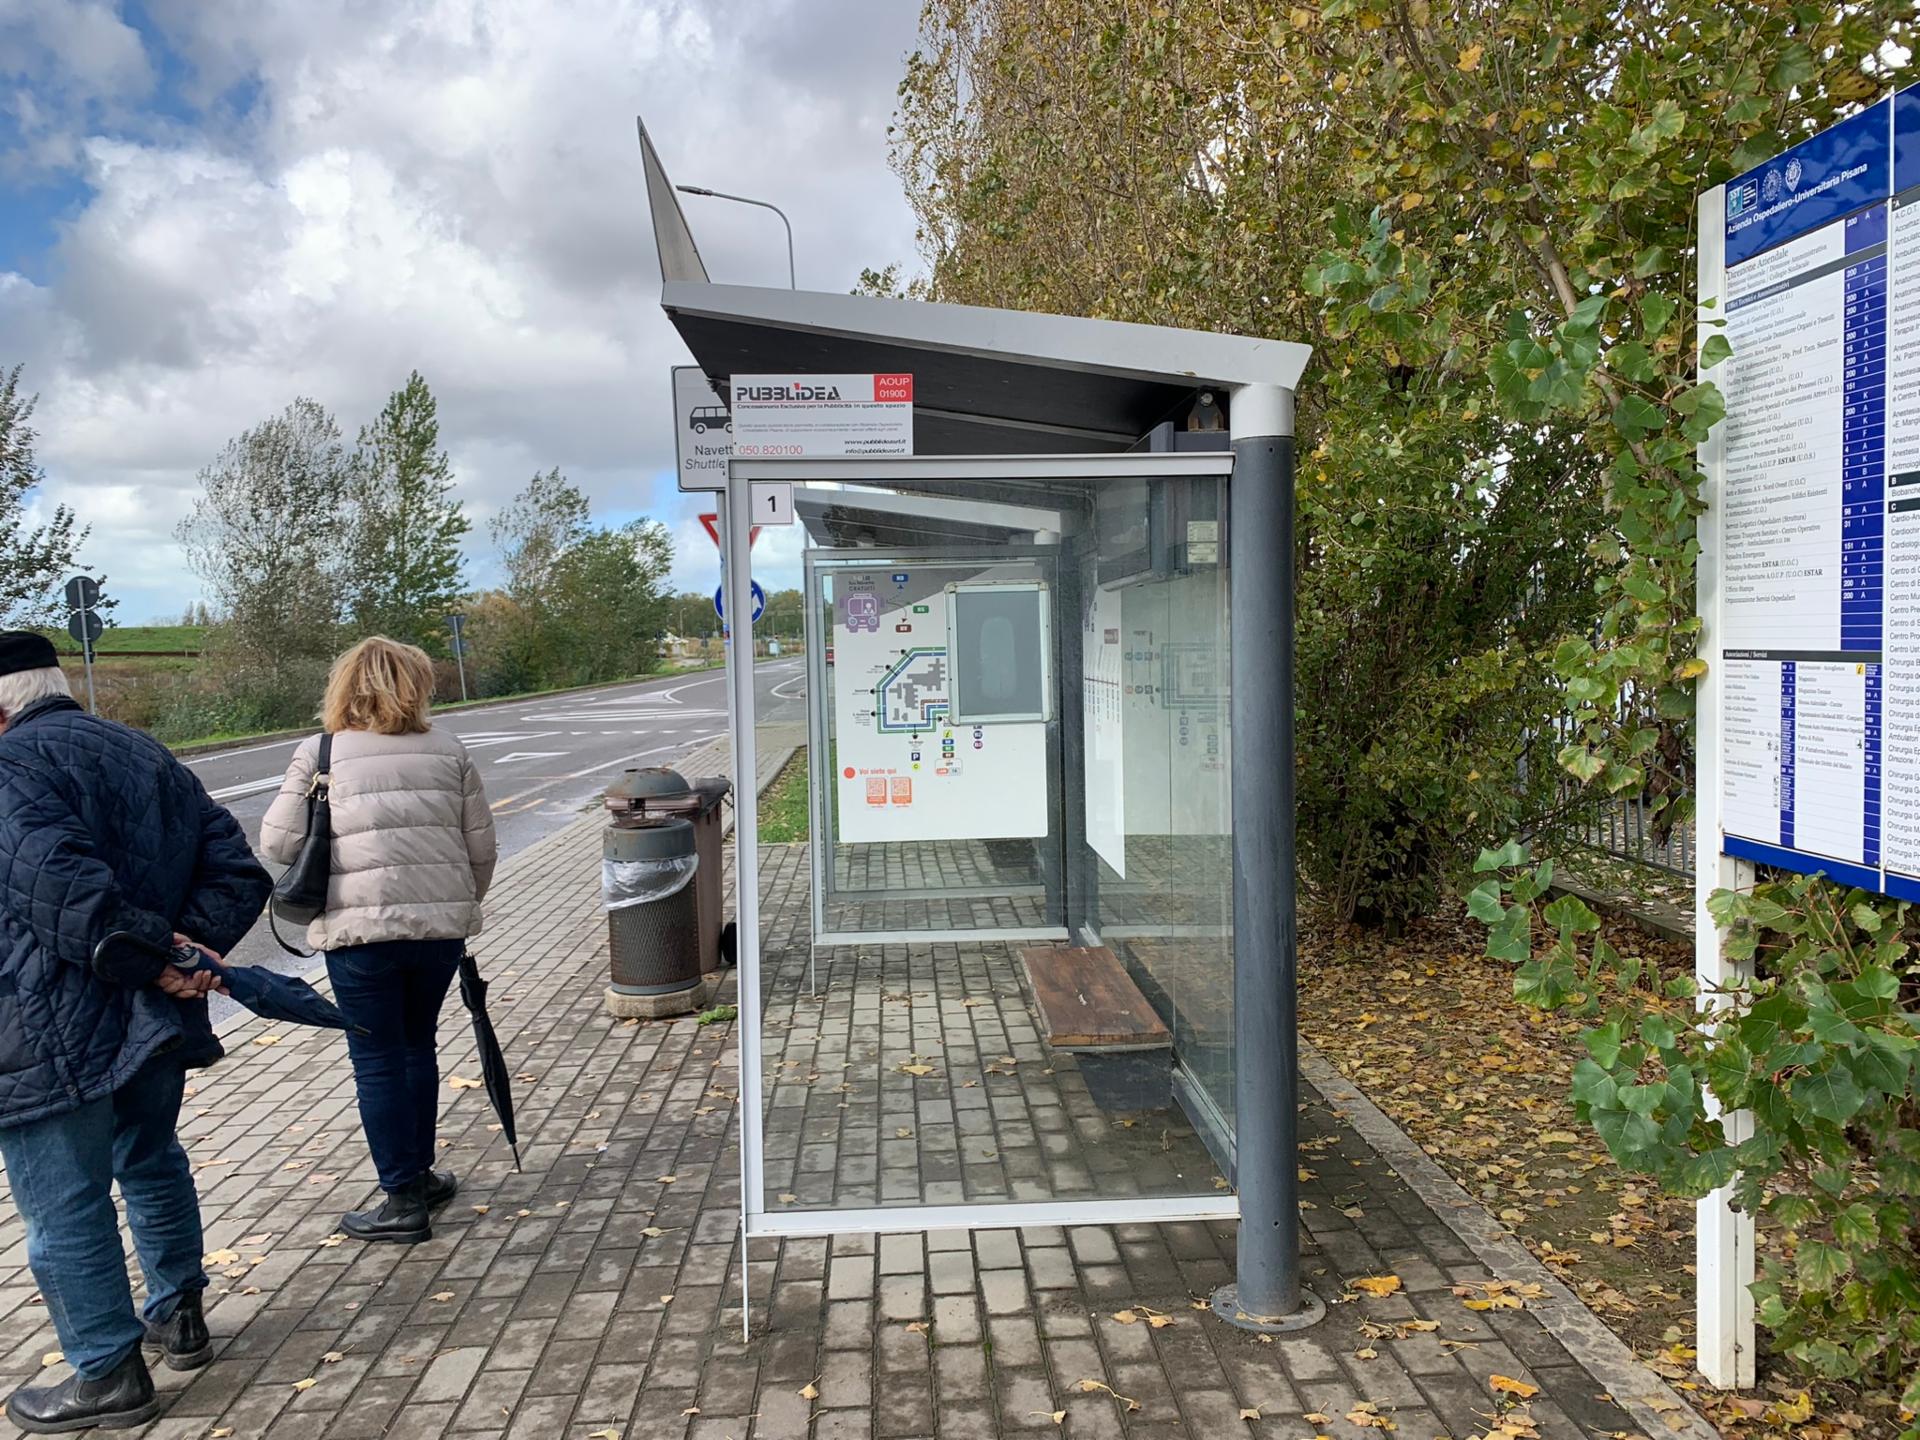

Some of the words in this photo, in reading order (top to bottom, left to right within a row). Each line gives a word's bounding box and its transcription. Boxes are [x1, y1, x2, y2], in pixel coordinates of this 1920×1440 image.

[1728, 216, 1752, 235] Azienda
[1753, 179, 1840, 221] Ospedaliero-Universitaria
[1841, 163, 1868, 182] Pisana
[879, 378, 910, 386] AOUP
[879, 389, 907, 398] 0190D
[740, 445, 803, 455] 050.820100
[685, 458, 725, 470] Shuttle
[767, 496, 776, 513] 1
